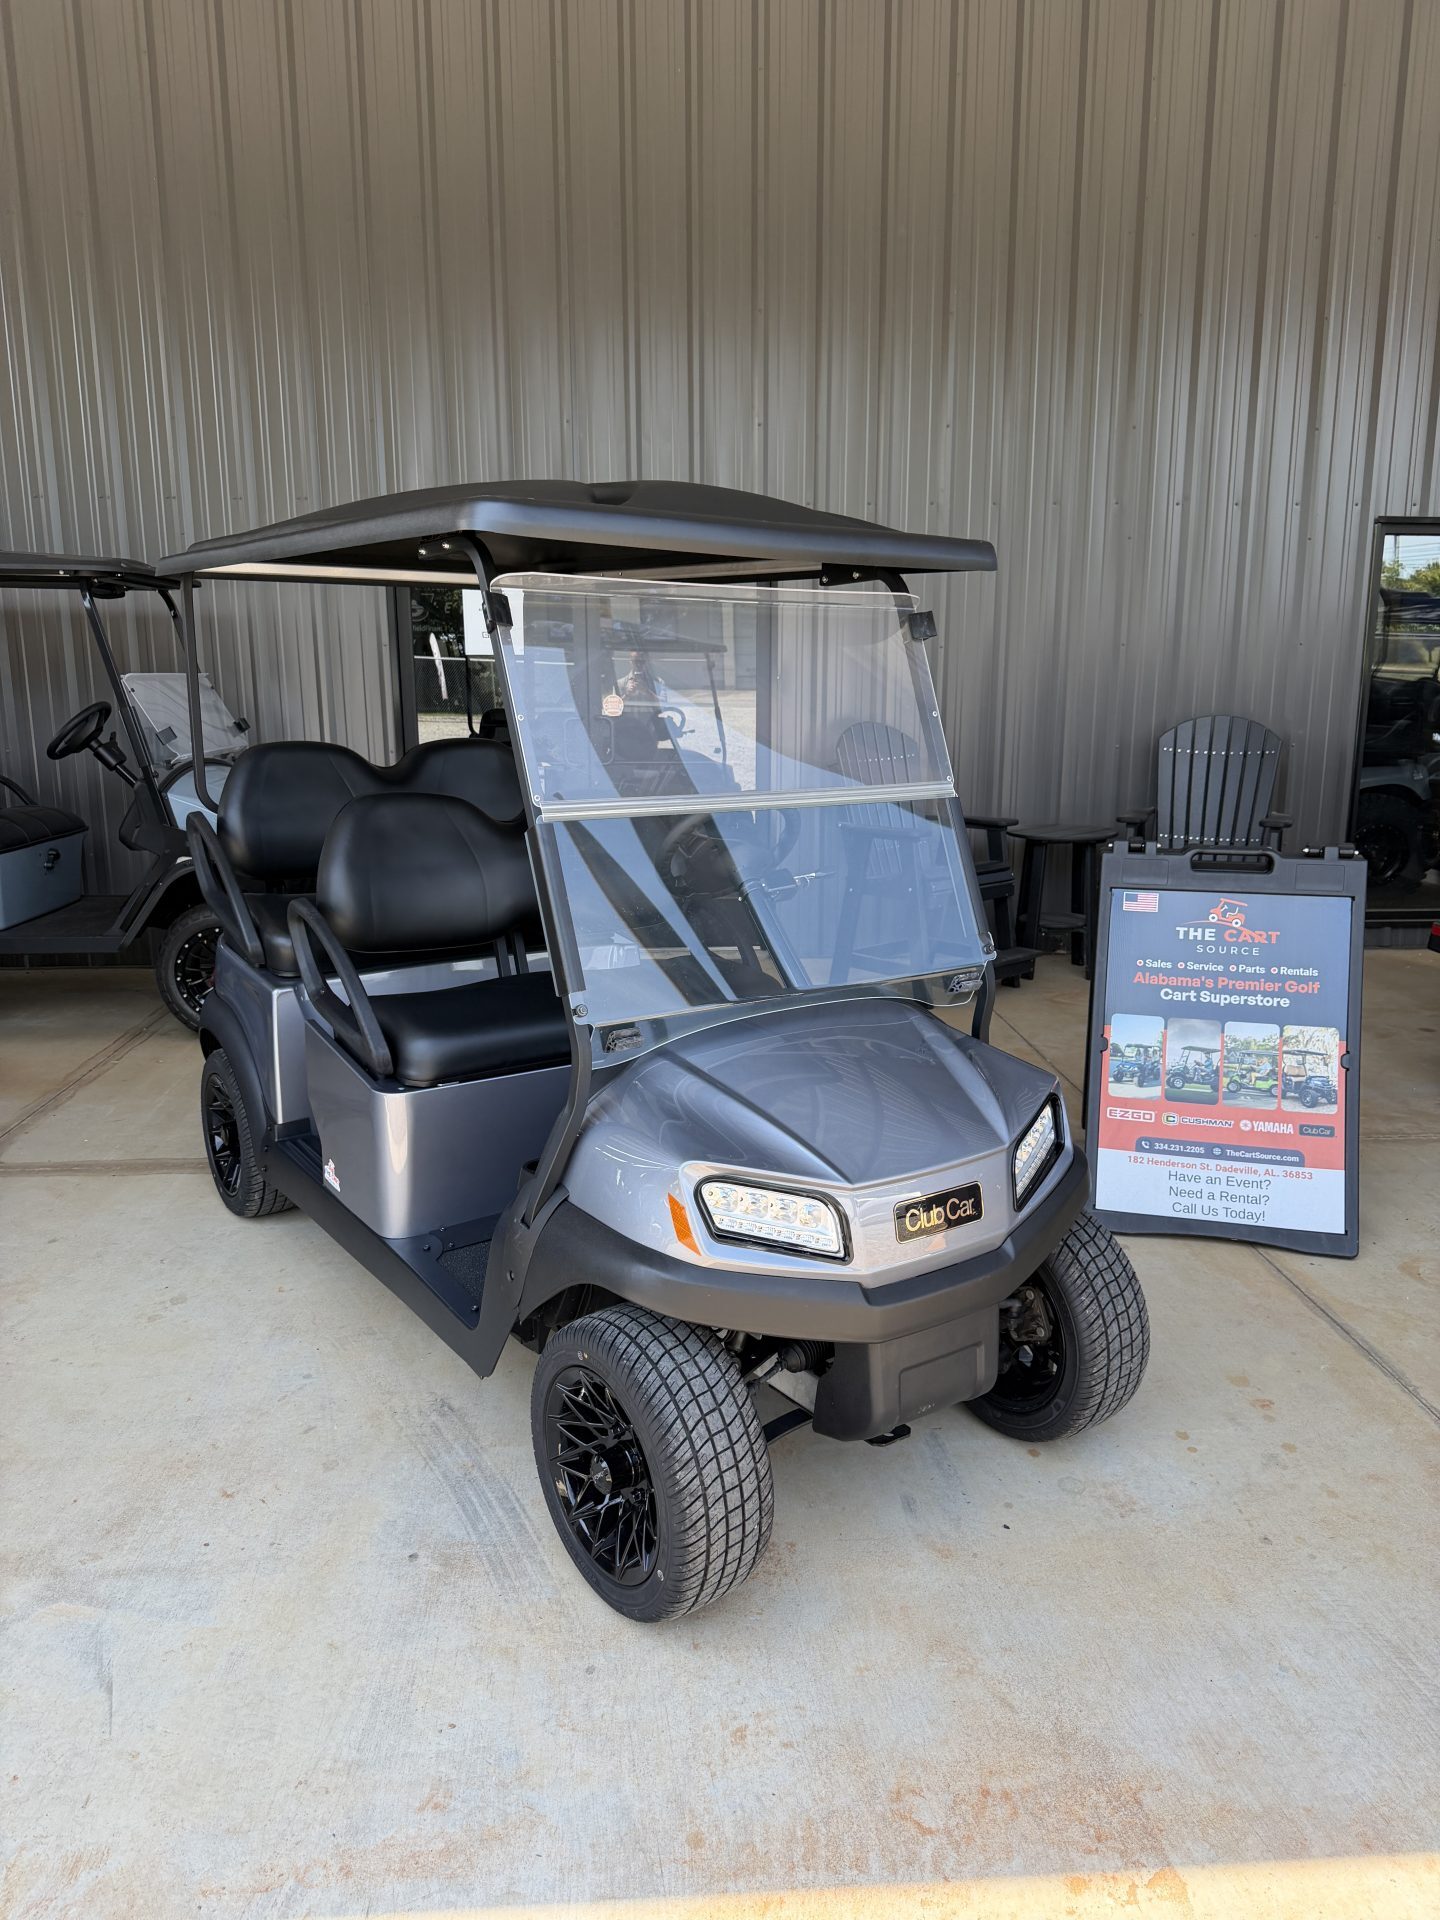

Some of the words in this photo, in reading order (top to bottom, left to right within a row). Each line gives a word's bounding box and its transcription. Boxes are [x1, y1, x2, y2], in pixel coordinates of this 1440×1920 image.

[1176, 927, 1216, 941] THE
[1223, 929, 1280, 944] CART
[1196, 944, 1260, 956] SOURCE
[1145, 959, 1172, 969] Sales
[1186, 961, 1224, 972] Service
[1238, 964, 1266, 974] Parts
[1280, 966, 1319, 977] Rentals
[1133, 971, 1214, 988] Alabama's
[1218, 976, 1282, 992] Premier
[1284, 980, 1320, 994] Golf
[1160, 988, 1197, 1002] Cart
[1199, 990, 1290, 1008] Superstore
[1181, 1116, 1233, 1127] CUSHMAN
[1252, 1121, 1294, 1135] YAMAHA
[1153, 1142, 1205, 1154] 334.231.2205
[1226, 1149, 1300, 1162] TheCartSource.com
[1128, 1155, 1145, 1165] 182
[1147, 1157, 1197, 1170] Henderson
[1200, 1162, 1213, 1171] St.
[1215, 1163, 1261, 1177] Dadeville,
[1263, 1169, 1280, 1178] AL.
[1282, 1169, 1313, 1180] 36853
[1168, 1170, 1201, 1183] Have
[1205, 1175, 1221, 1186] an
[1226, 1175, 1271, 1190] Event?
[1169, 1185, 1203, 1199] Need
[1207, 1191, 1216, 1201] a
[1220, 1190, 1270, 1206] Rental?
[905, 1204, 945, 1232] Club
[1172, 1201, 1197, 1215] Call
[1201, 1204, 1219, 1217] Us
[1222, 1206, 1265, 1224] Today!
